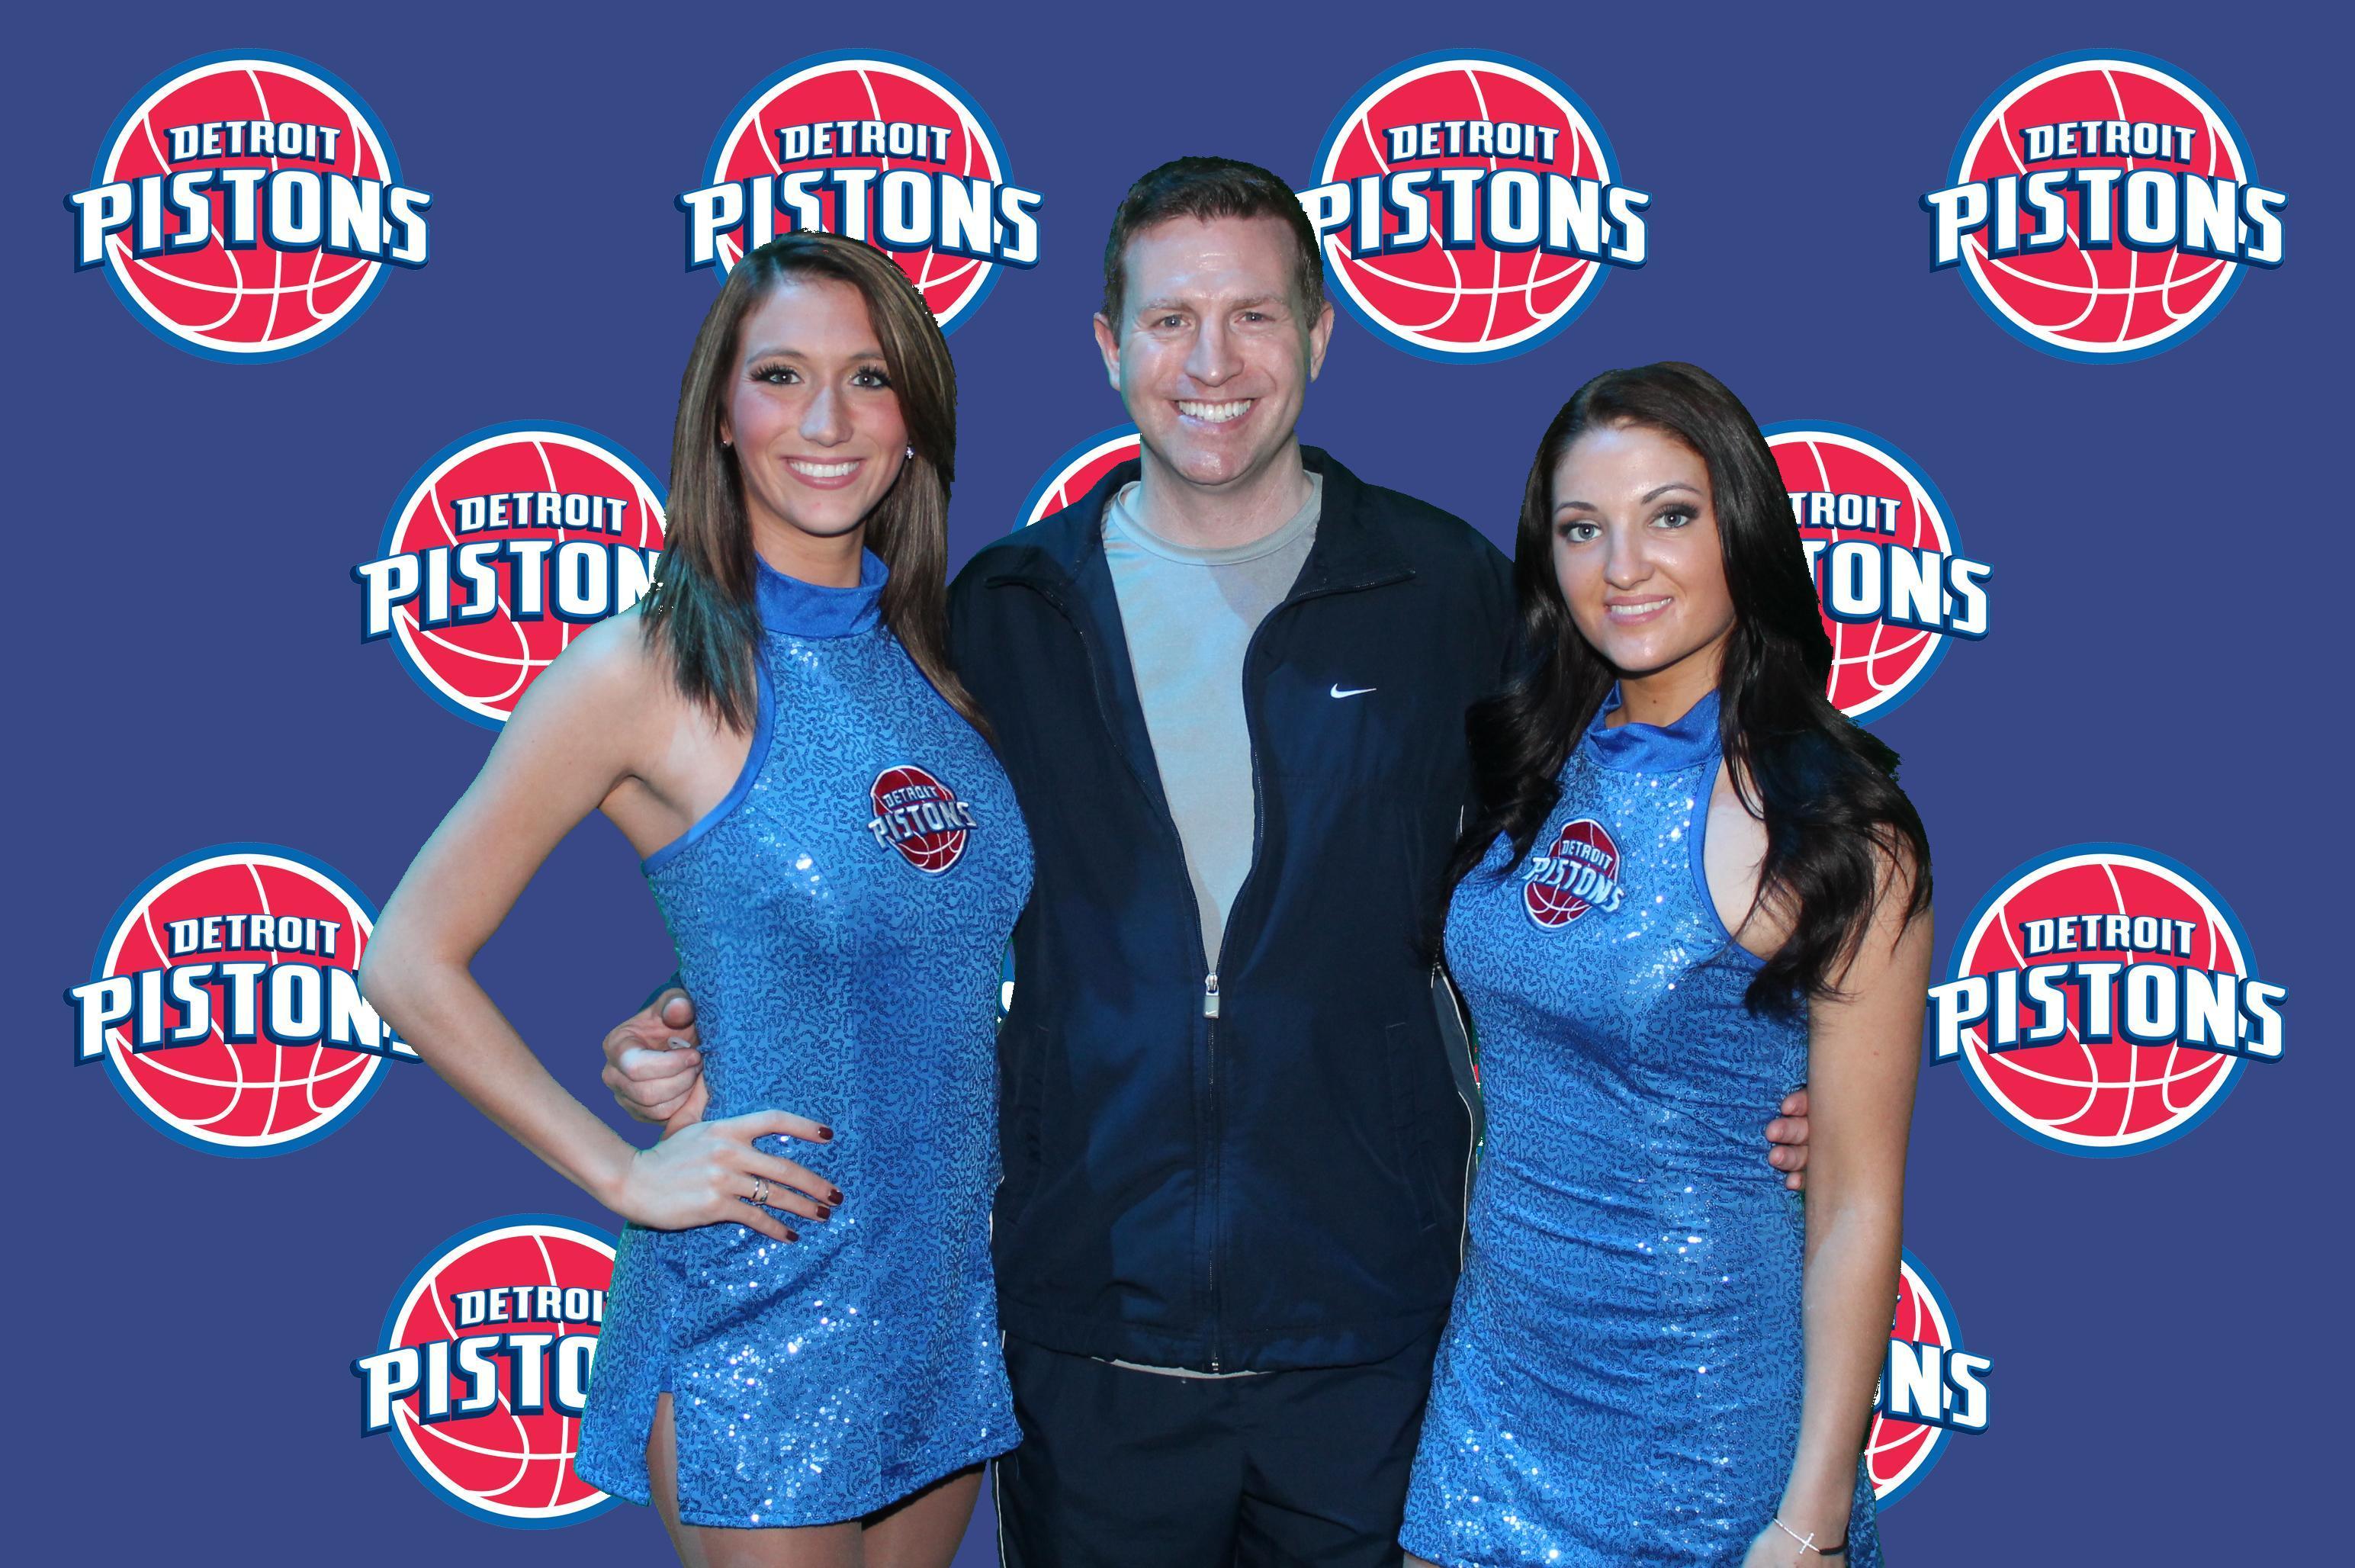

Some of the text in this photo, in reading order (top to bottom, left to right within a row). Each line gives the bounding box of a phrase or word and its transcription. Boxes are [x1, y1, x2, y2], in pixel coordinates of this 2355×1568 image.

[165, 120, 341, 163] DETROIT
[776, 120, 952, 163] DETROIT
[1384, 120, 1560, 163] DETROIT
[2022, 120, 2196, 163] DETROIT
[66, 167, 433, 272] PISTONS
[676, 167, 1043, 272] PISTONS
[1294, 167, 1652, 269] PISTONS
[1920, 167, 2288, 272] PISTONS
[453, 491, 628, 535] DETROIT
[1788, 492, 1901, 535] TROIT
[352, 538, 663, 642] PISTON
[882, 785, 940, 808] DETROIT
[868, 801, 978, 850] PISTONS
[1561, 840, 1614, 872] DETROIT
[1521, 857, 1625, 913] PISTONS
[165, 914, 341, 957] DETROIT
[2022, 914, 2196, 957] DETROIT
[1927, 961, 2288, 1065] PISTONS
[453, 1286, 609, 1329] DETROI
[352, 1333, 599, 1437] PISTO
